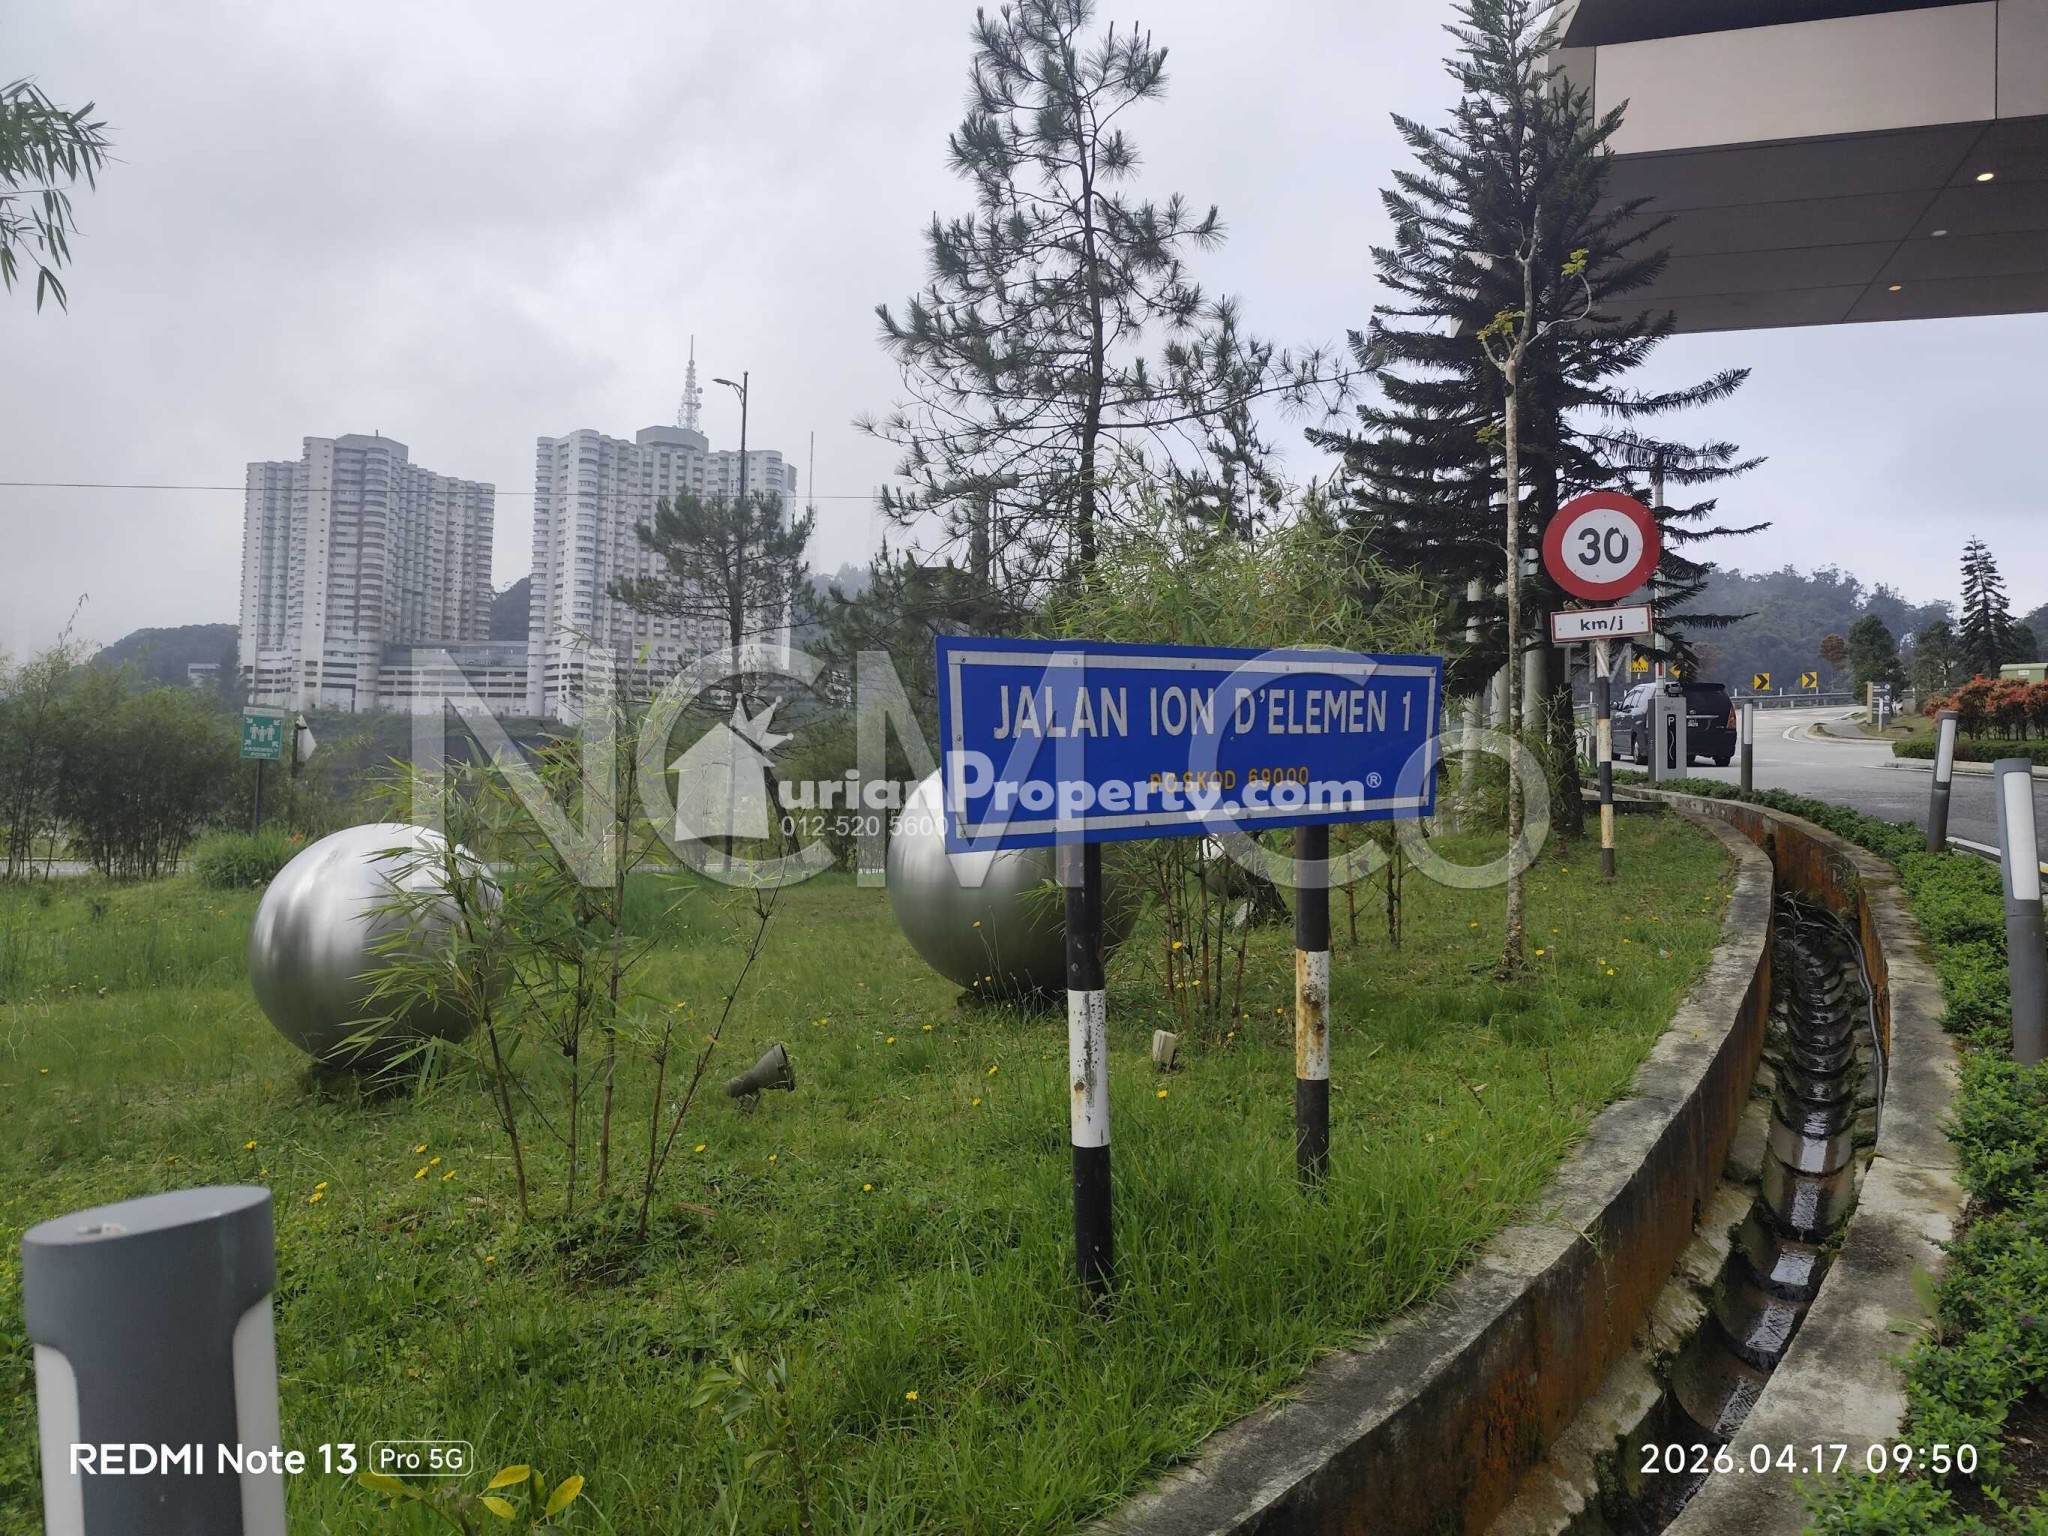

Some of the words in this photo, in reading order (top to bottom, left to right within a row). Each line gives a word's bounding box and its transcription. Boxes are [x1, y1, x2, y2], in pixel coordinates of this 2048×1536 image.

[1578, 527, 1629, 566] 30
[1580, 616, 1623, 631] km/j
[993, 685, 1128, 739] JALAN
[1150, 686, 1215, 736] ION
[1234, 687, 1387, 735] D'ELEMEN
[1402, 690, 1412, 732] 1
[1149, 769, 1236, 794] POSKOD
[1248, 766, 1310, 788] 69000
